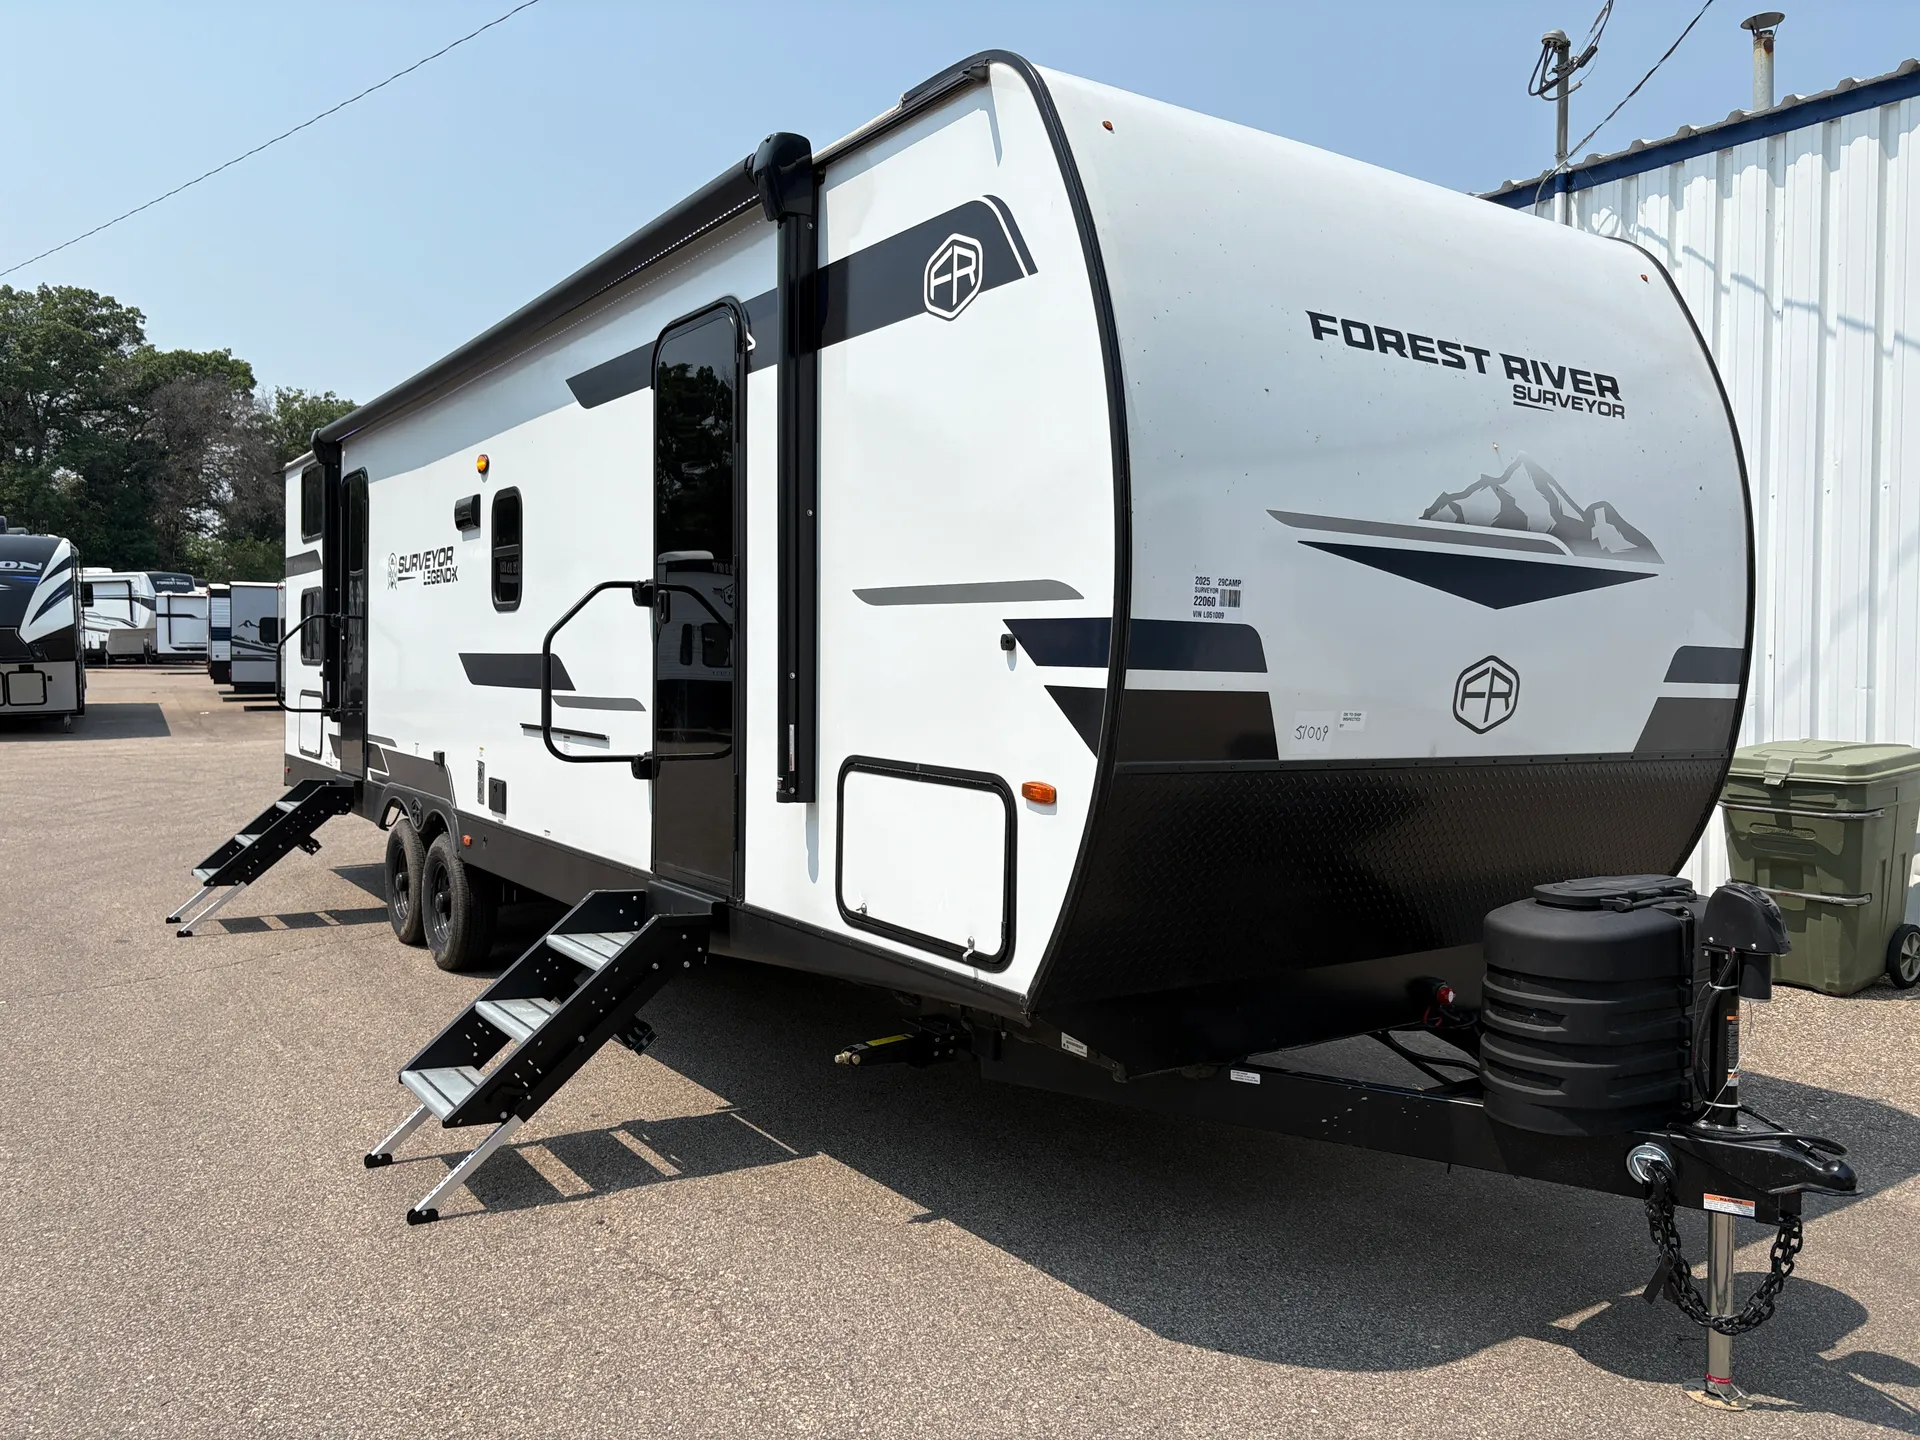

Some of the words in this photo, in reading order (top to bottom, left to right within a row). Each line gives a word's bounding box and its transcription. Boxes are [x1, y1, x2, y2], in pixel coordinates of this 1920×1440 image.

[1305, 310, 1491, 374] FOREST
[1498, 352, 1622, 401] RIVER
[1512, 384, 1626, 419] SURVEYOR
[398, 545, 454, 574] SURVEYOR
[1195, 576, 1210, 586] 2025
[1194, 586, 1219, 594] SURVEYOR
[1193, 595, 1216, 607] 22060
[1192, 610, 1202, 618] VIN
[1294, 724, 1329, 742] 51009
